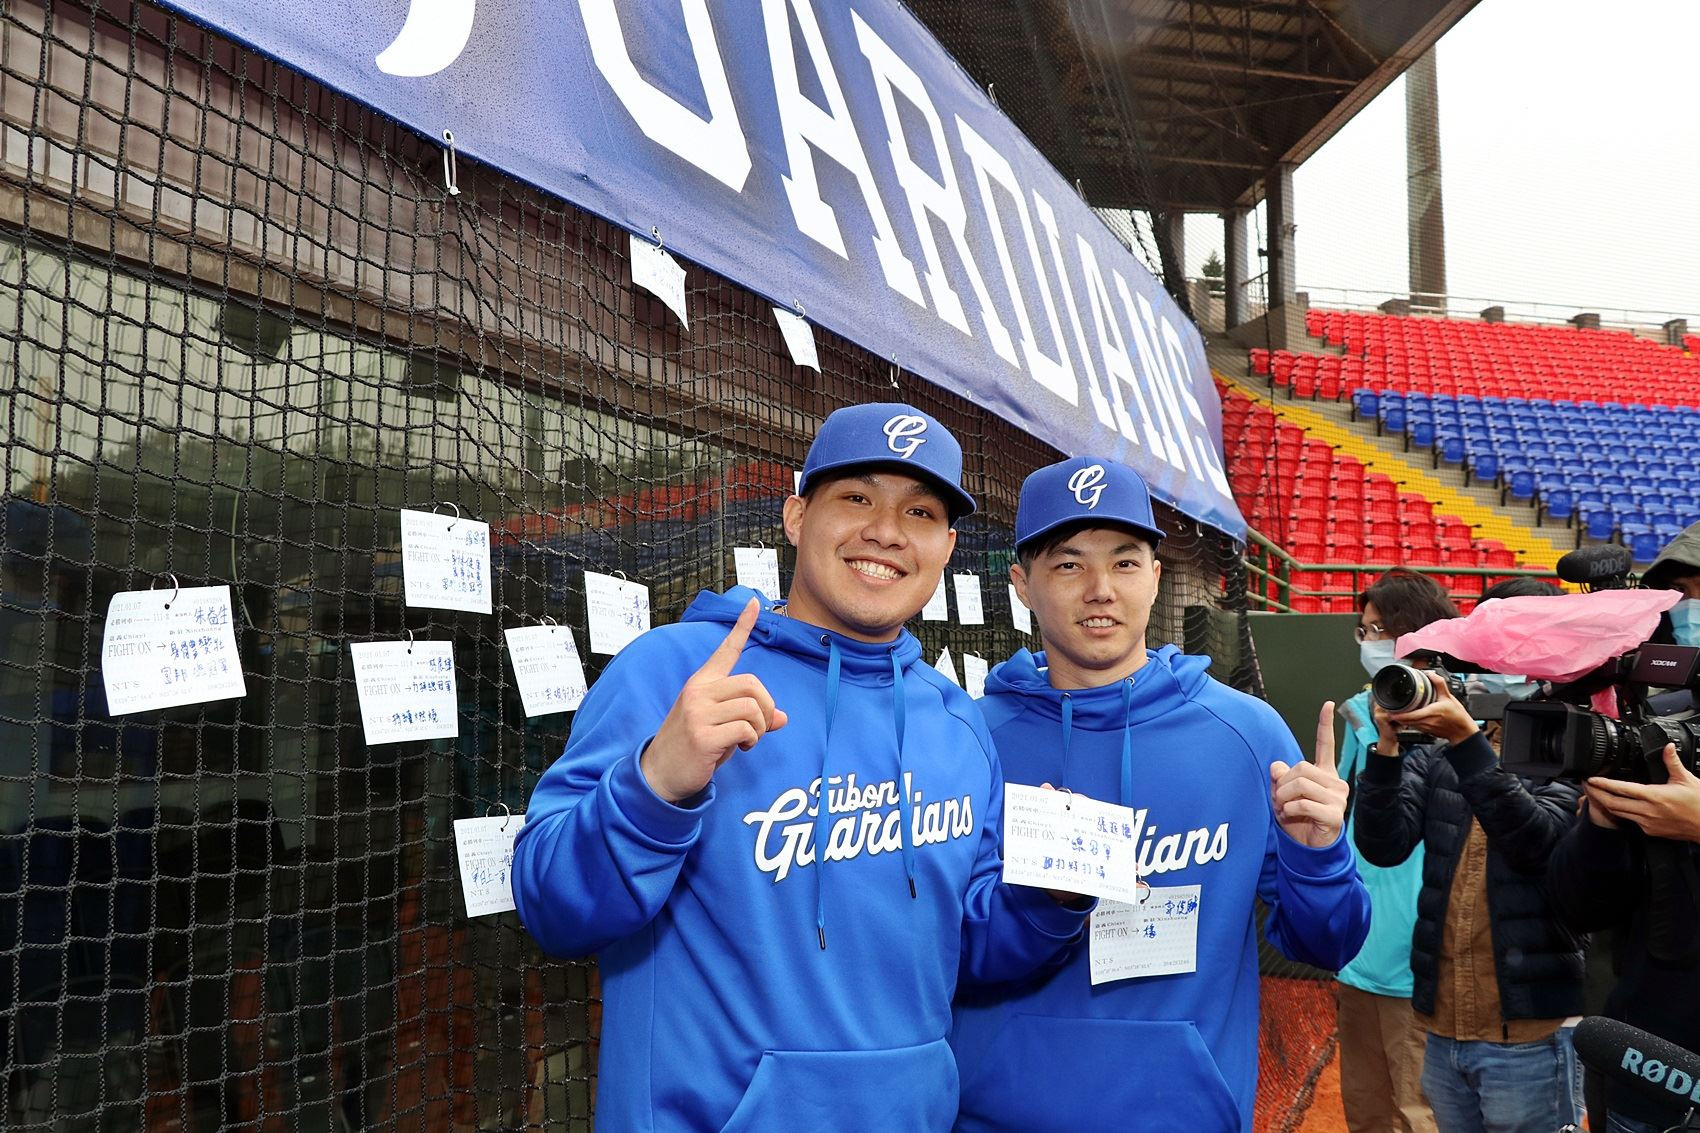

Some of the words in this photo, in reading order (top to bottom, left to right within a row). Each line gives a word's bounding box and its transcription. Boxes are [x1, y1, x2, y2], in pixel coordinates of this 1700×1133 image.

[408, 551, 429, 563] FIGHT
[431, 553, 440, 564] ON
[1590, 556, 1624, 577] RØDE
[194, 604, 228, 625] 朱益生
[108, 643, 135, 658] FIGHT
[138, 641, 152, 656] ON
[519, 663, 539, 676] FIGHT
[363, 684, 388, 697] FIGHT
[390, 683, 401, 695] ON
[808, 773, 899, 817] Fubon
[1011, 825, 1040, 840] FIGHT
[1041, 829, 1055, 842] ON
[465, 857, 487, 871] FIGHT
[487, 856, 497, 867] ON
[1094, 929, 1116, 941] FIGHT
[1117, 926, 1130, 938] ON
